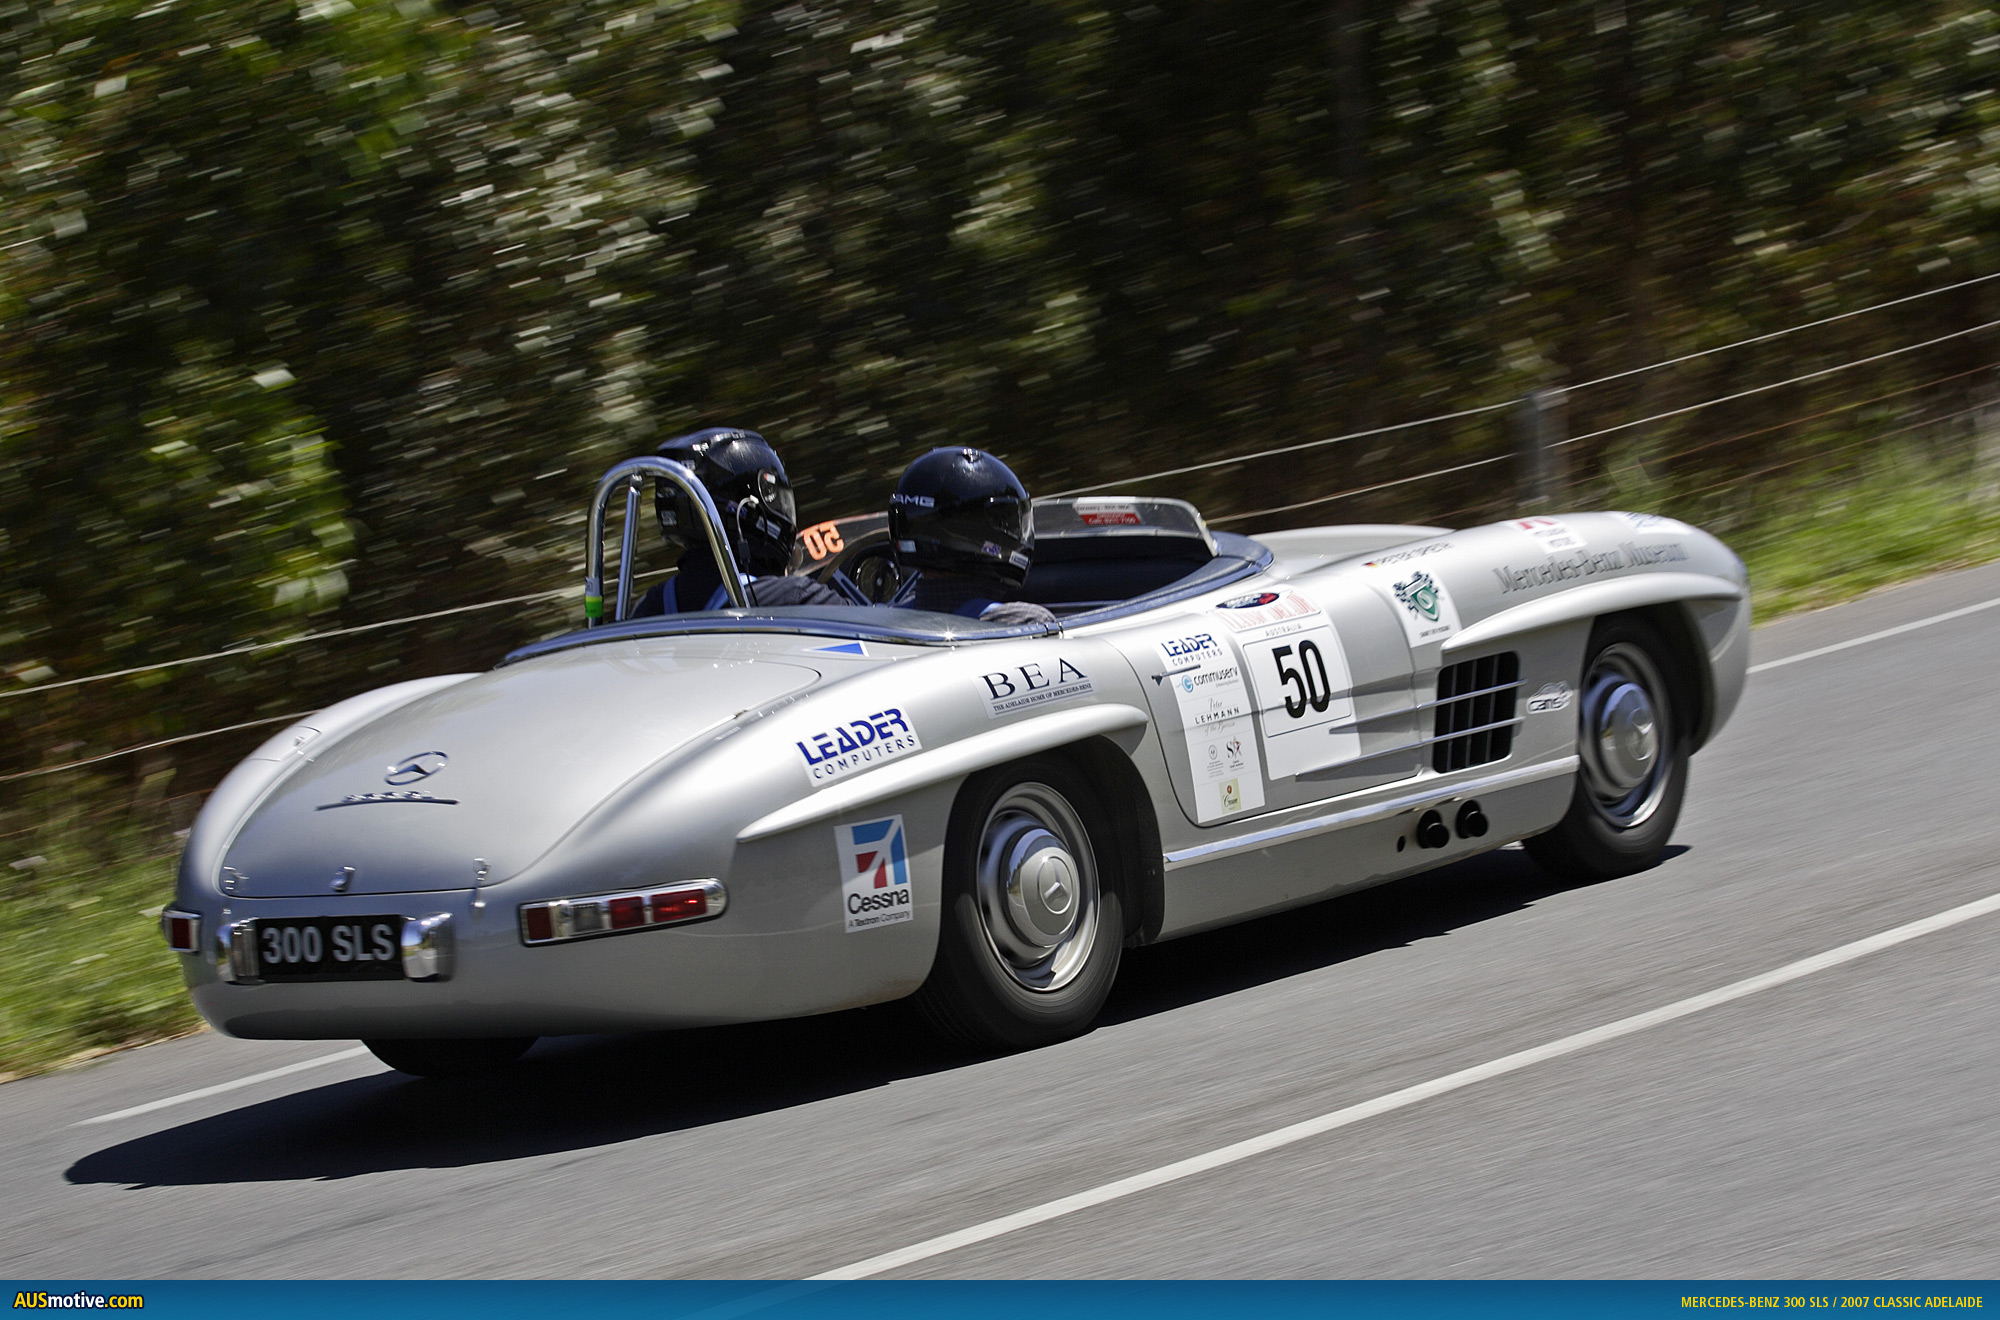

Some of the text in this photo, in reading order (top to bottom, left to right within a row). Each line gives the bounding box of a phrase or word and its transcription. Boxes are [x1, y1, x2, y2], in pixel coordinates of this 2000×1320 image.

[893, 494, 935, 508] AMG
[1493, 550, 1624, 594] Mercedes-Benz
[1161, 633, 1218, 657] LEADER
[1172, 648, 1223, 666] COMPUTERS
[978, 657, 1088, 701] BEA
[1272, 639, 1331, 719] 50
[1195, 707, 1240, 724] LEHMANN
[796, 708, 908, 766] LEADER
[813, 735, 915, 779] COMPUTERS
[848, 889, 910, 914] Cessna
[262, 924, 396, 963] 300 SLS
